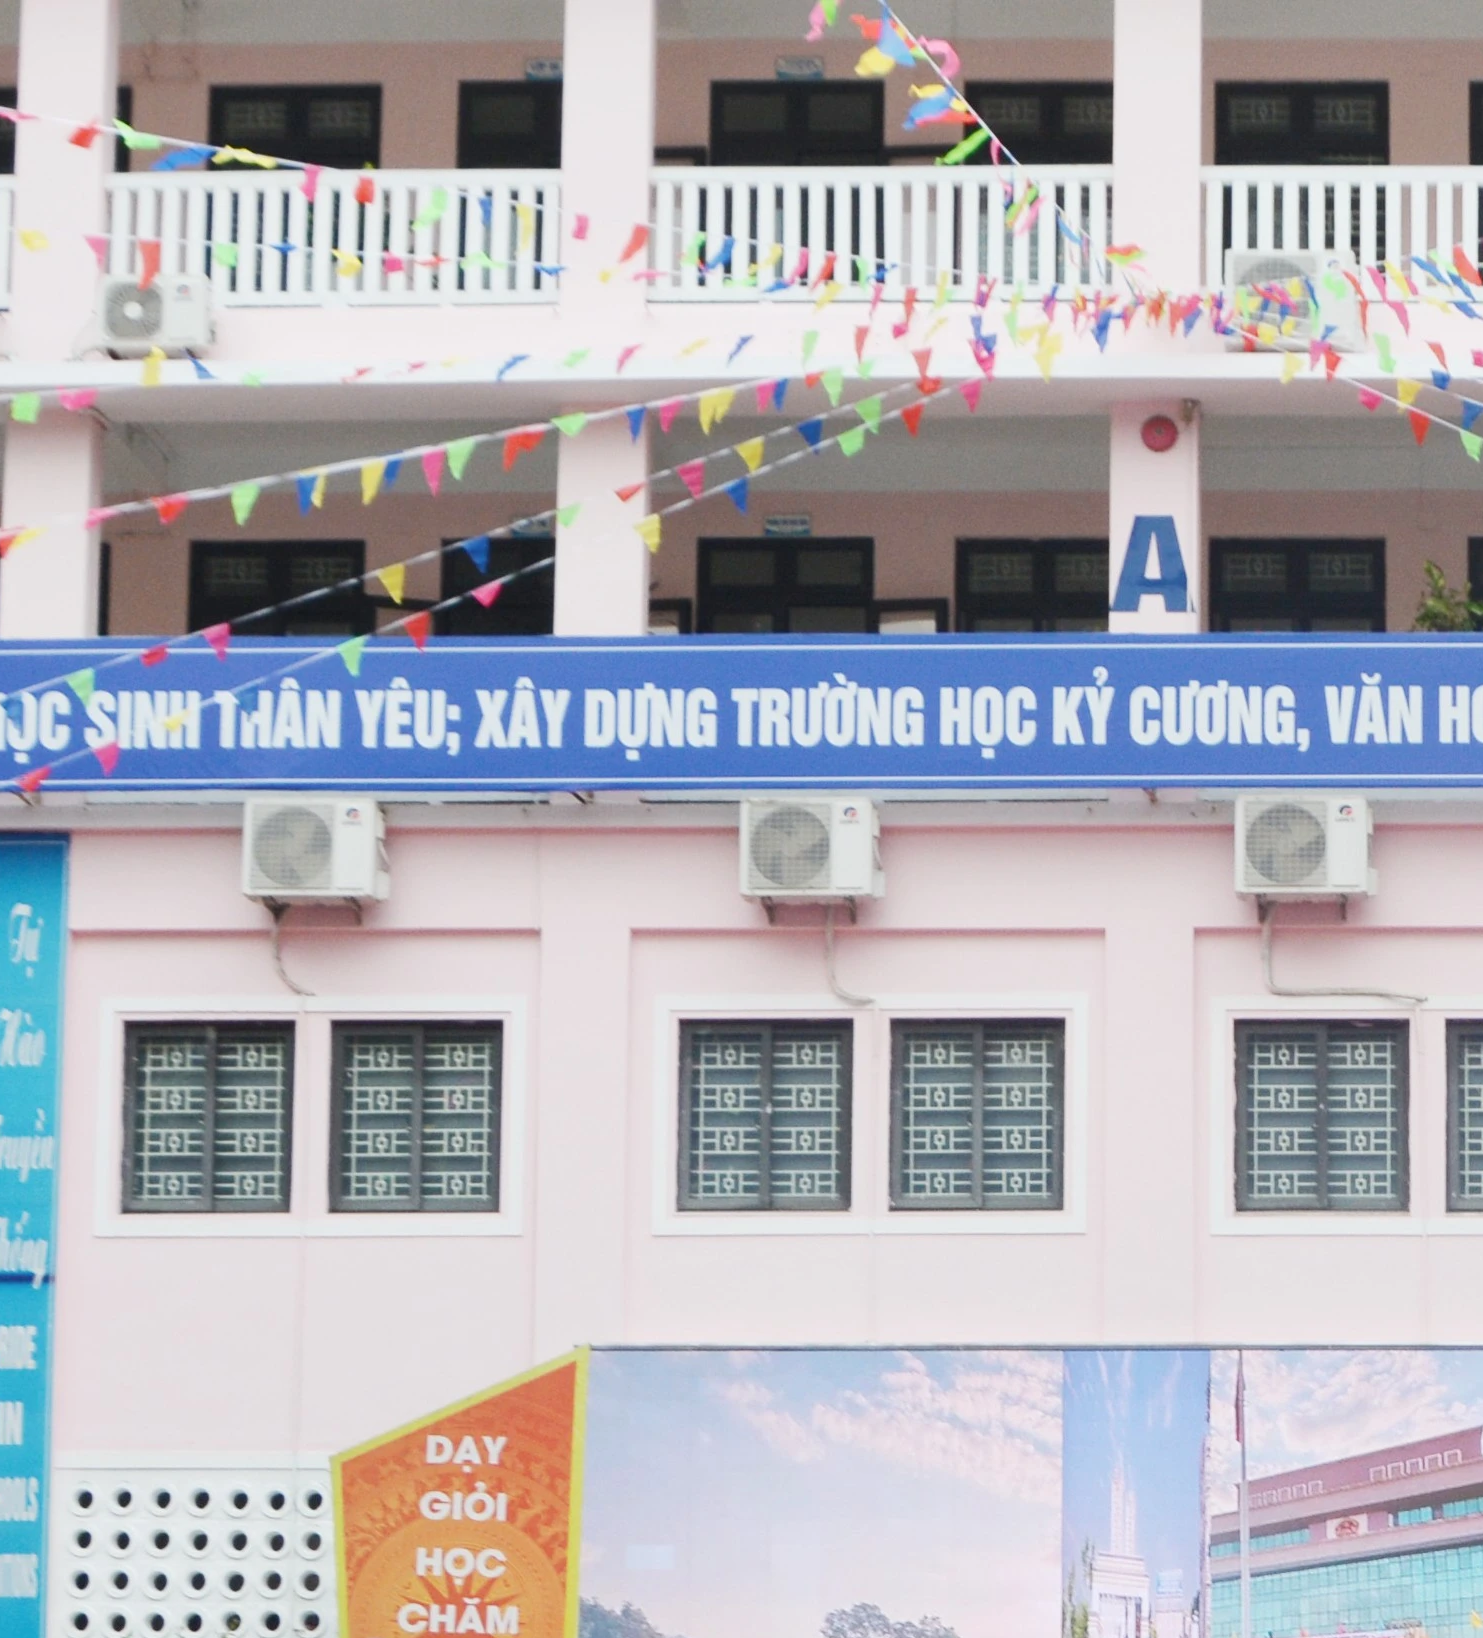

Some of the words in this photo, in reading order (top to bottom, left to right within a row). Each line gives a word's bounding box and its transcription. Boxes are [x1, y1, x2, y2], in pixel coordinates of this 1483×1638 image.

[1111, 515, 1187, 612] A
[83, 689, 201, 750] SINH
[213, 676, 341, 749] THÂN
[354, 676, 460, 756] YÊU;
[475, 676, 571, 749] XÂY
[584, 682, 717, 761] DỰNG
[731, 672, 925, 746] TRƯỜNG
[939, 685, 1037, 758] HỌC
[1053, 666, 1115, 745] KỶ
[1129, 680, 1310, 751] CƯƠNG,
[1324, 672, 1423, 744] VĂN
[426, 1435, 507, 1473] DẠY
[419, 1481, 507, 1521] GIỎI
[416, 1547, 507, 1585] HỌC
[397, 1597, 519, 1634] CHĂM
